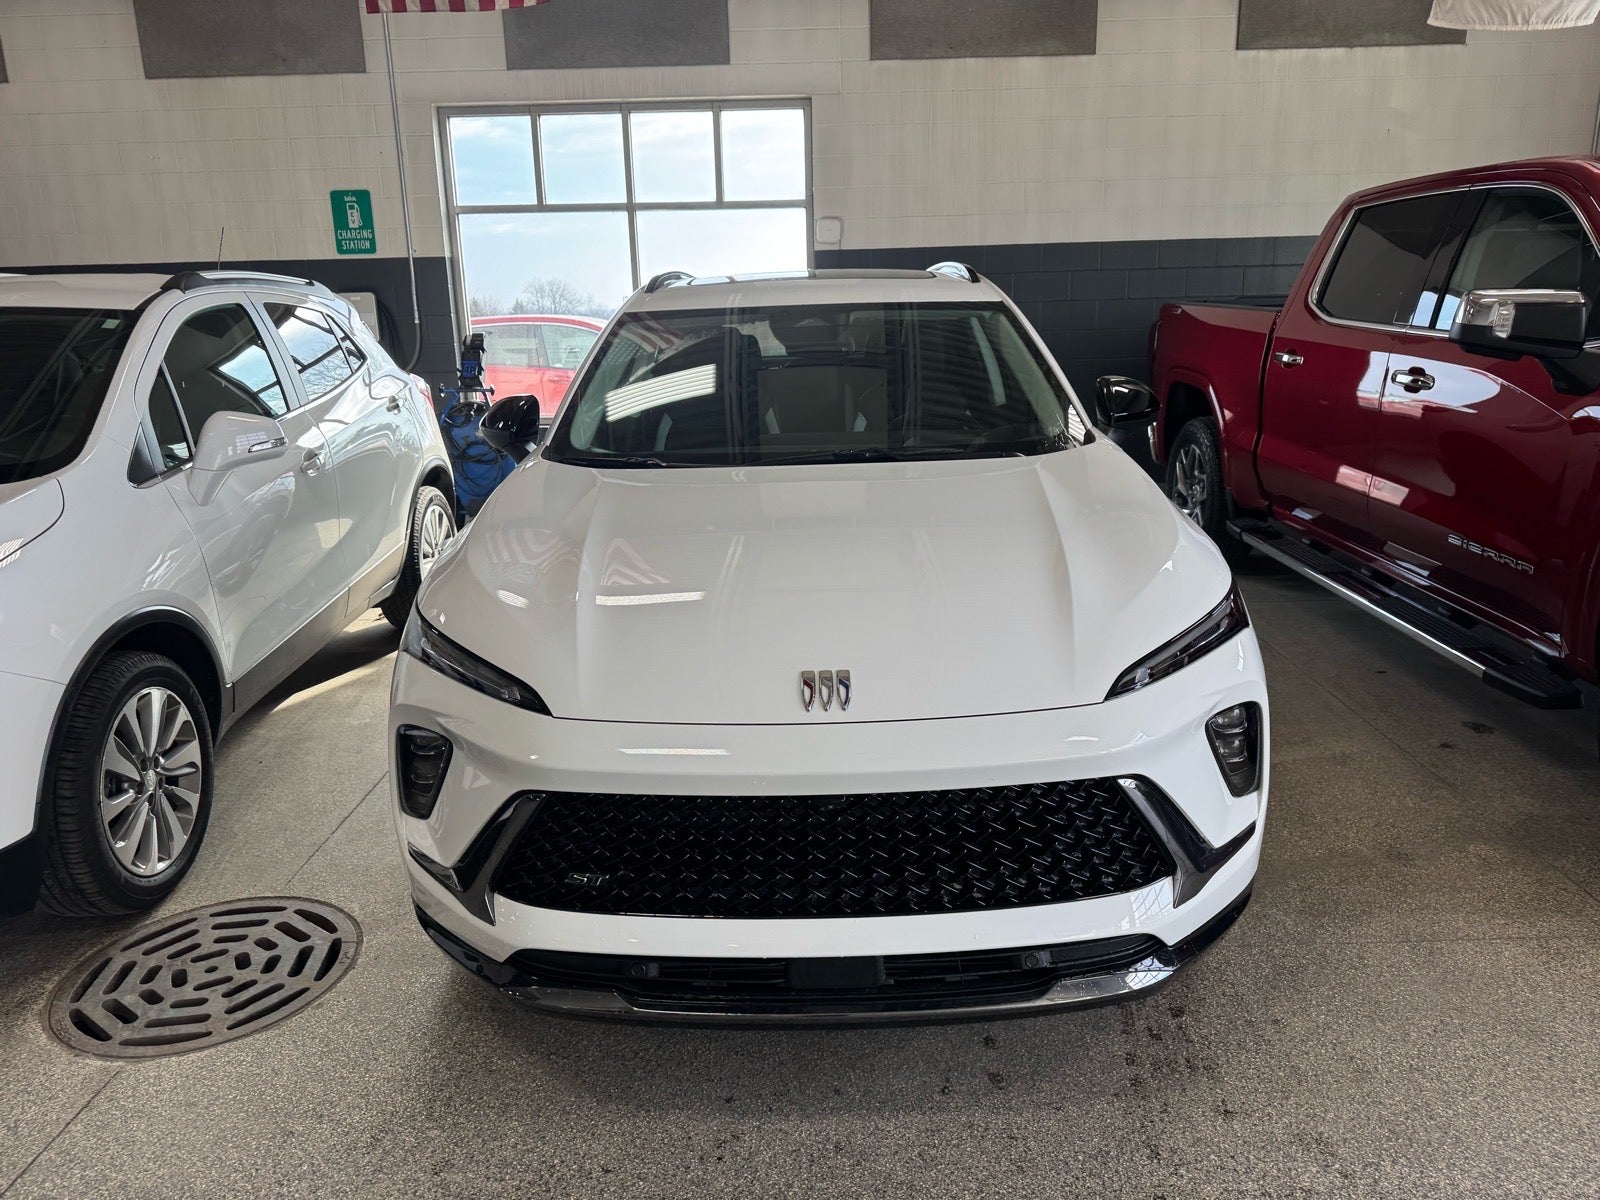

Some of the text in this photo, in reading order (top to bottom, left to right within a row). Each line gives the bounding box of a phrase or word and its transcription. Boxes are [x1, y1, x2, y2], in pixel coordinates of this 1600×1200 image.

[337, 229, 372, 239] CHARGING
[341, 240, 371, 250] STATION
[1447, 534, 1534, 575] SIERRA
